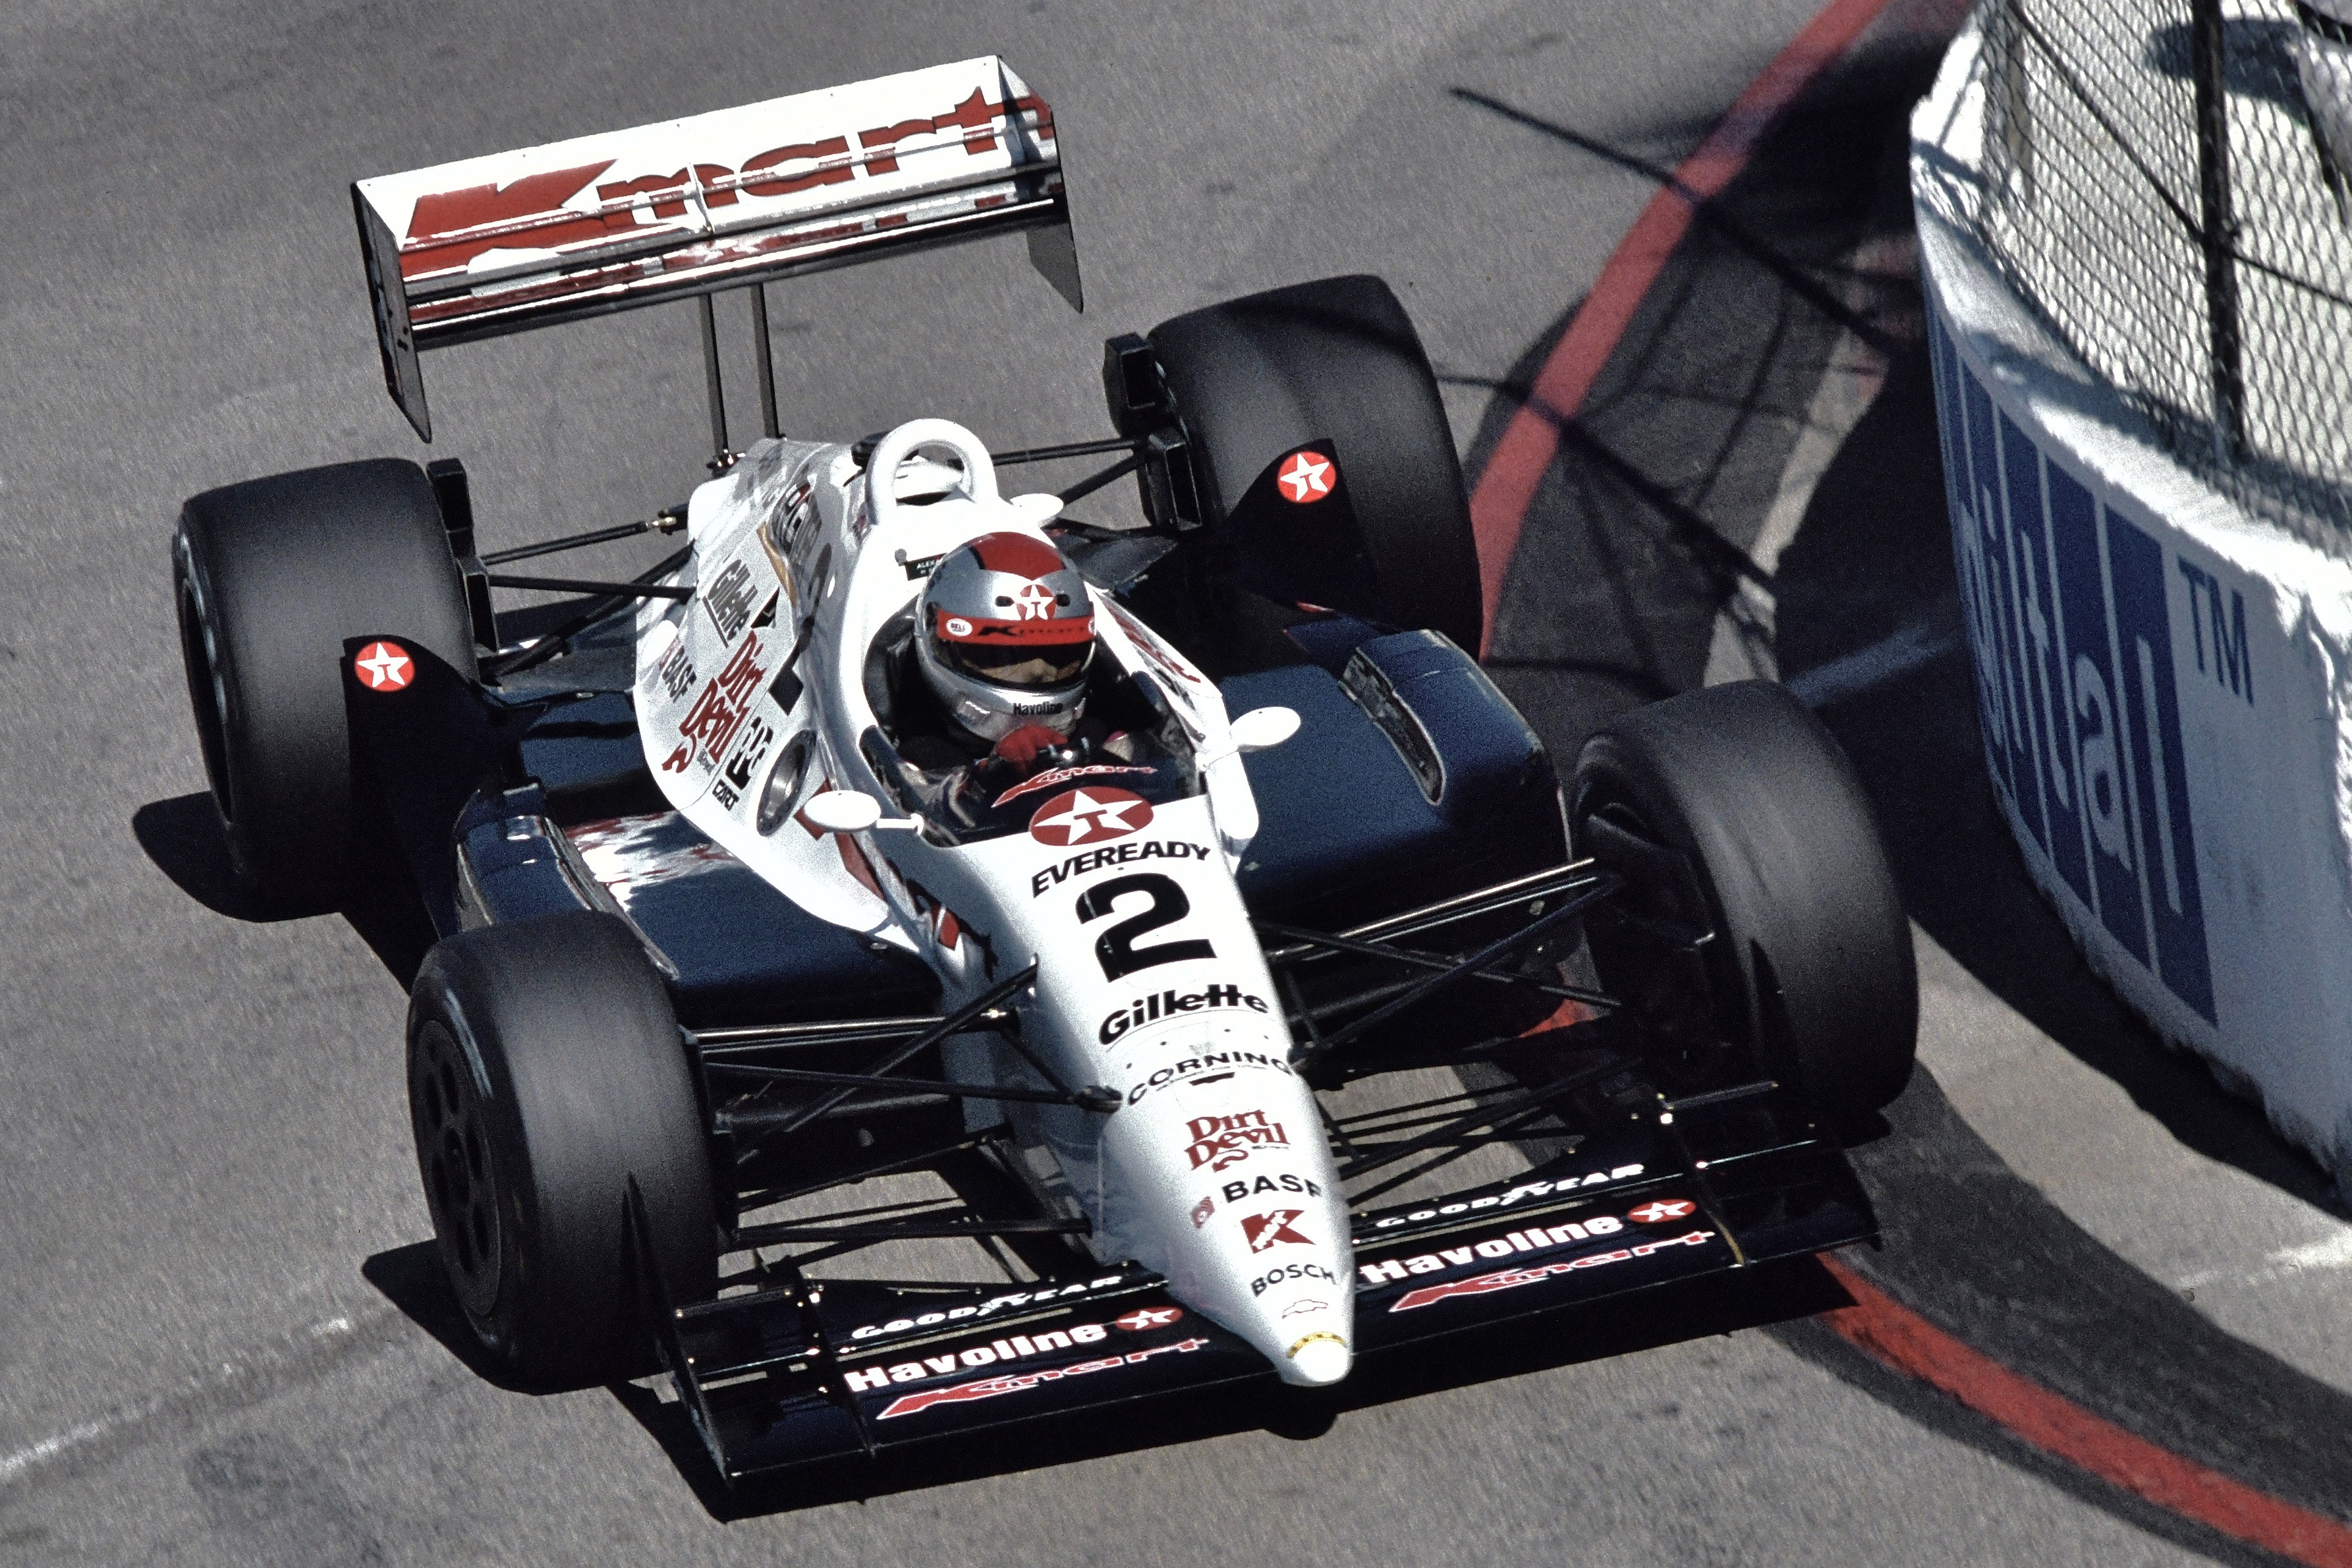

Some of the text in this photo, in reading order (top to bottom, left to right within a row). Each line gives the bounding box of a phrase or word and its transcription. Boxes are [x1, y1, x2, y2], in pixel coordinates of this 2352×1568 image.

[679, 677, 750, 764] Devil
[1013, 702, 1063, 715] Havoline
[712, 779, 739, 811] CART
[1031, 841, 1211, 899] EVEREADY
[1075, 872, 1218, 983] 2
[1098, 984, 1268, 1045] Gillette
[1183, 1123, 1291, 1171] Devil
[1185, 1109, 1269, 1143] Dirt
[1376, 1163, 1644, 1228] GOODYEAR
[1359, 1216, 1623, 1284] Havoline
[1388, 1231, 1716, 1313] Kmart
[851, 1275, 1122, 1339] GOODYEAR
[1250, 1270, 1337, 1297] BOSCH
[843, 1323, 1109, 1392] Havoline
[876, 1337, 1210, 1420] Kmart
